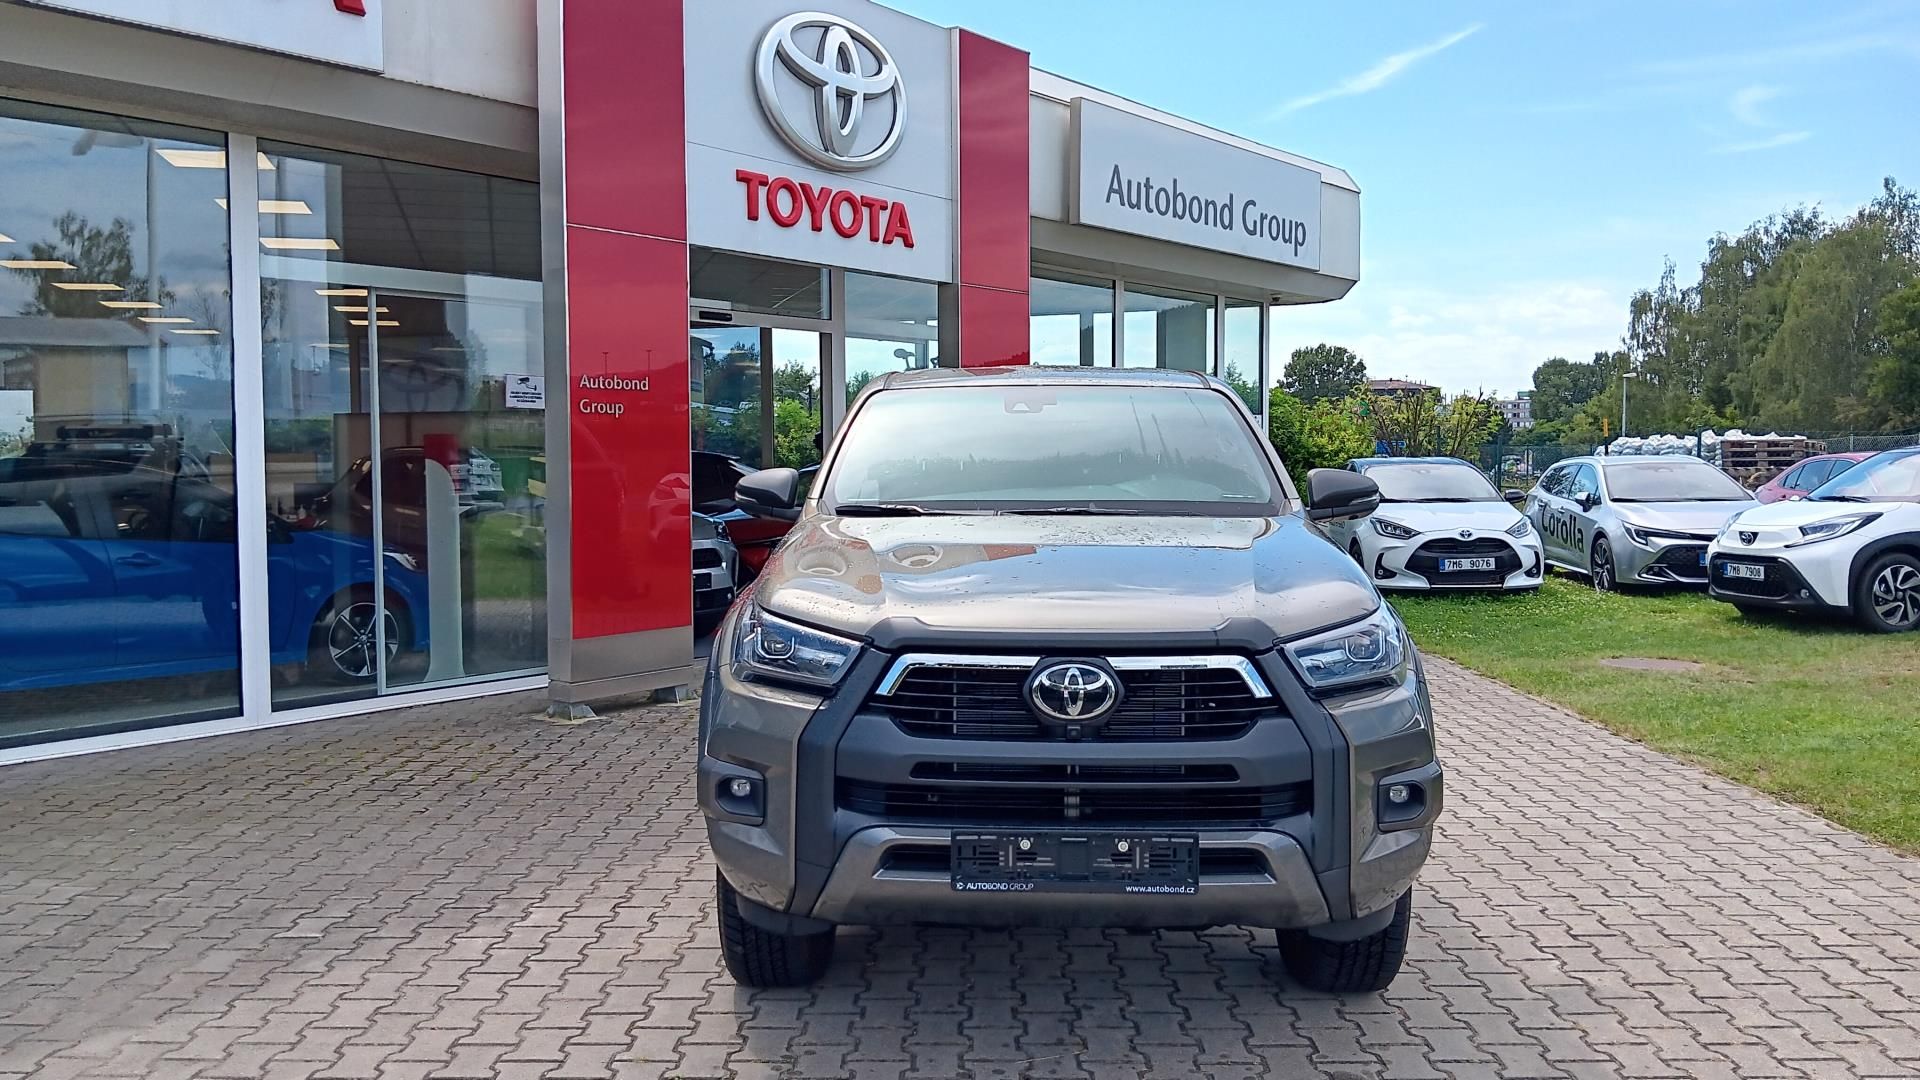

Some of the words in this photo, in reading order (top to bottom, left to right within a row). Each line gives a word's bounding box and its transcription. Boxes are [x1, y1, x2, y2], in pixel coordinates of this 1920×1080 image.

[735, 169, 915, 249] TOYOTA
[1105, 163, 1234, 231] Autobond
[1241, 199, 1307, 257] Group
[579, 374, 649, 391] Autobond
[579, 399, 625, 418] Group
[1541, 502, 1585, 554] Corolla
[1446, 560, 1463, 570] 7M6
[1469, 559, 1492, 569] 9076
[966, 882, 1008, 890] AUTOBOND
[1009, 883, 1034, 891] GROUP
[1125, 884, 1195, 894] www.autobond.cz
